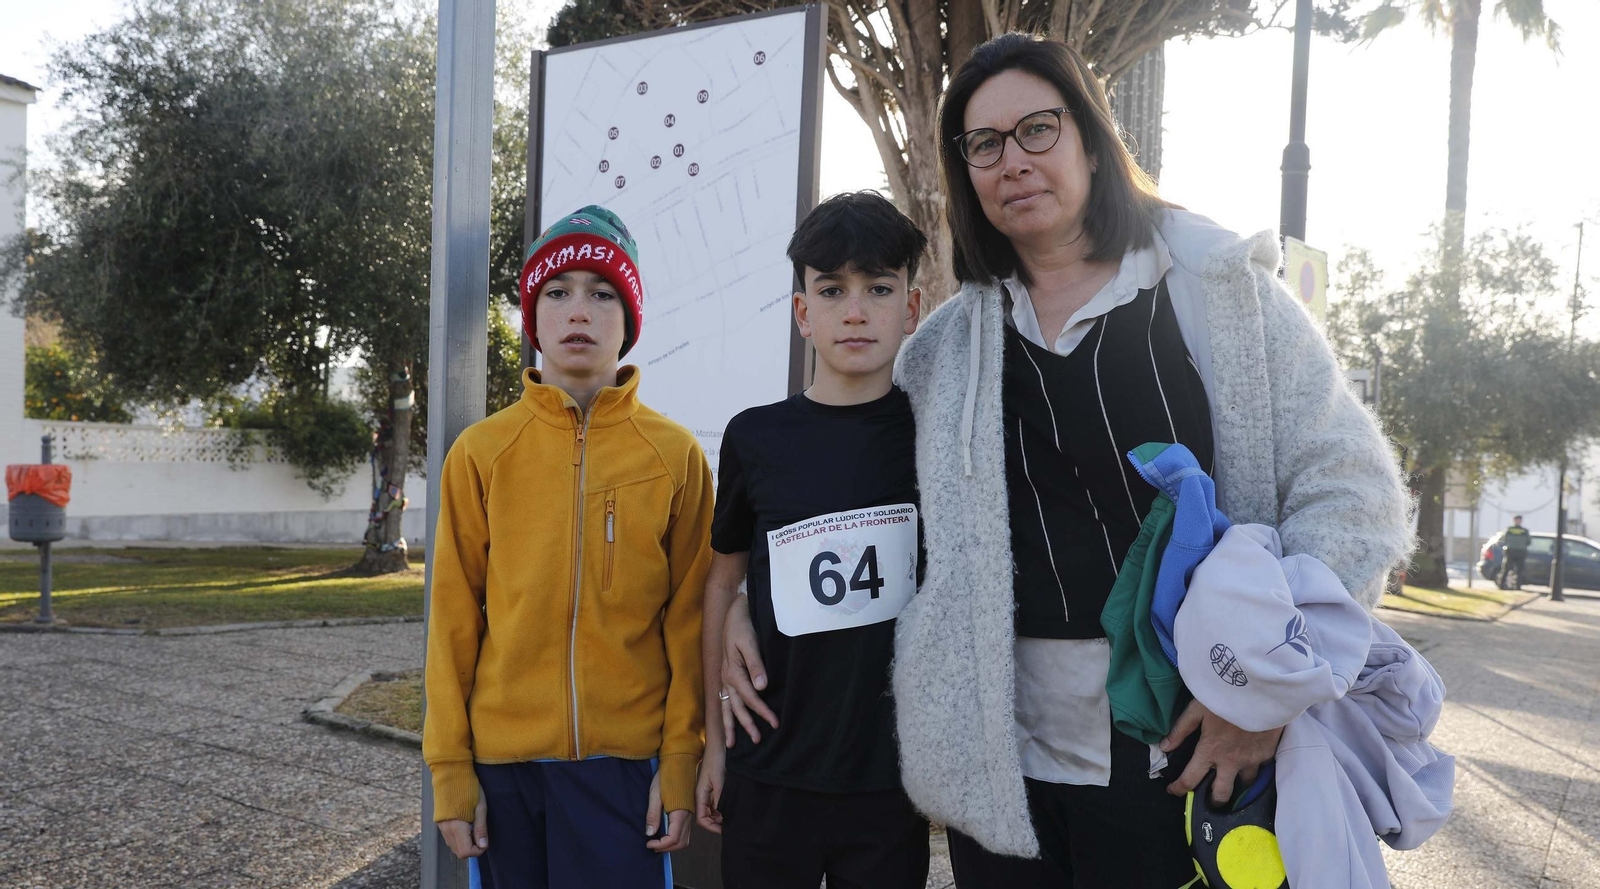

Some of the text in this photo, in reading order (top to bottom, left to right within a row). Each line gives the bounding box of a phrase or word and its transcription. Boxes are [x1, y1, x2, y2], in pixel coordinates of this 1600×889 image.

[755, 53, 764, 63] 06
[638, 83, 647, 93] 03
[698, 91, 708, 101] 09
[665, 116, 675, 126] 04
[609, 128, 618, 138] 05
[674, 146, 683, 155] 01
[600, 161, 609, 171] 10
[651, 157, 661, 167] 02
[689, 165, 699, 175] 08
[615, 177, 625, 187] 07
[775, 526, 797, 539] CROSS
[798, 517, 834, 531] POPULAR
[835, 512, 866, 523] LÚDICO
[873, 507, 914, 517] SOLIDARIO
[775, 515, 910, 547] CASTELLAR DE LA FRONTERA
[808, 544, 885, 606] 64
